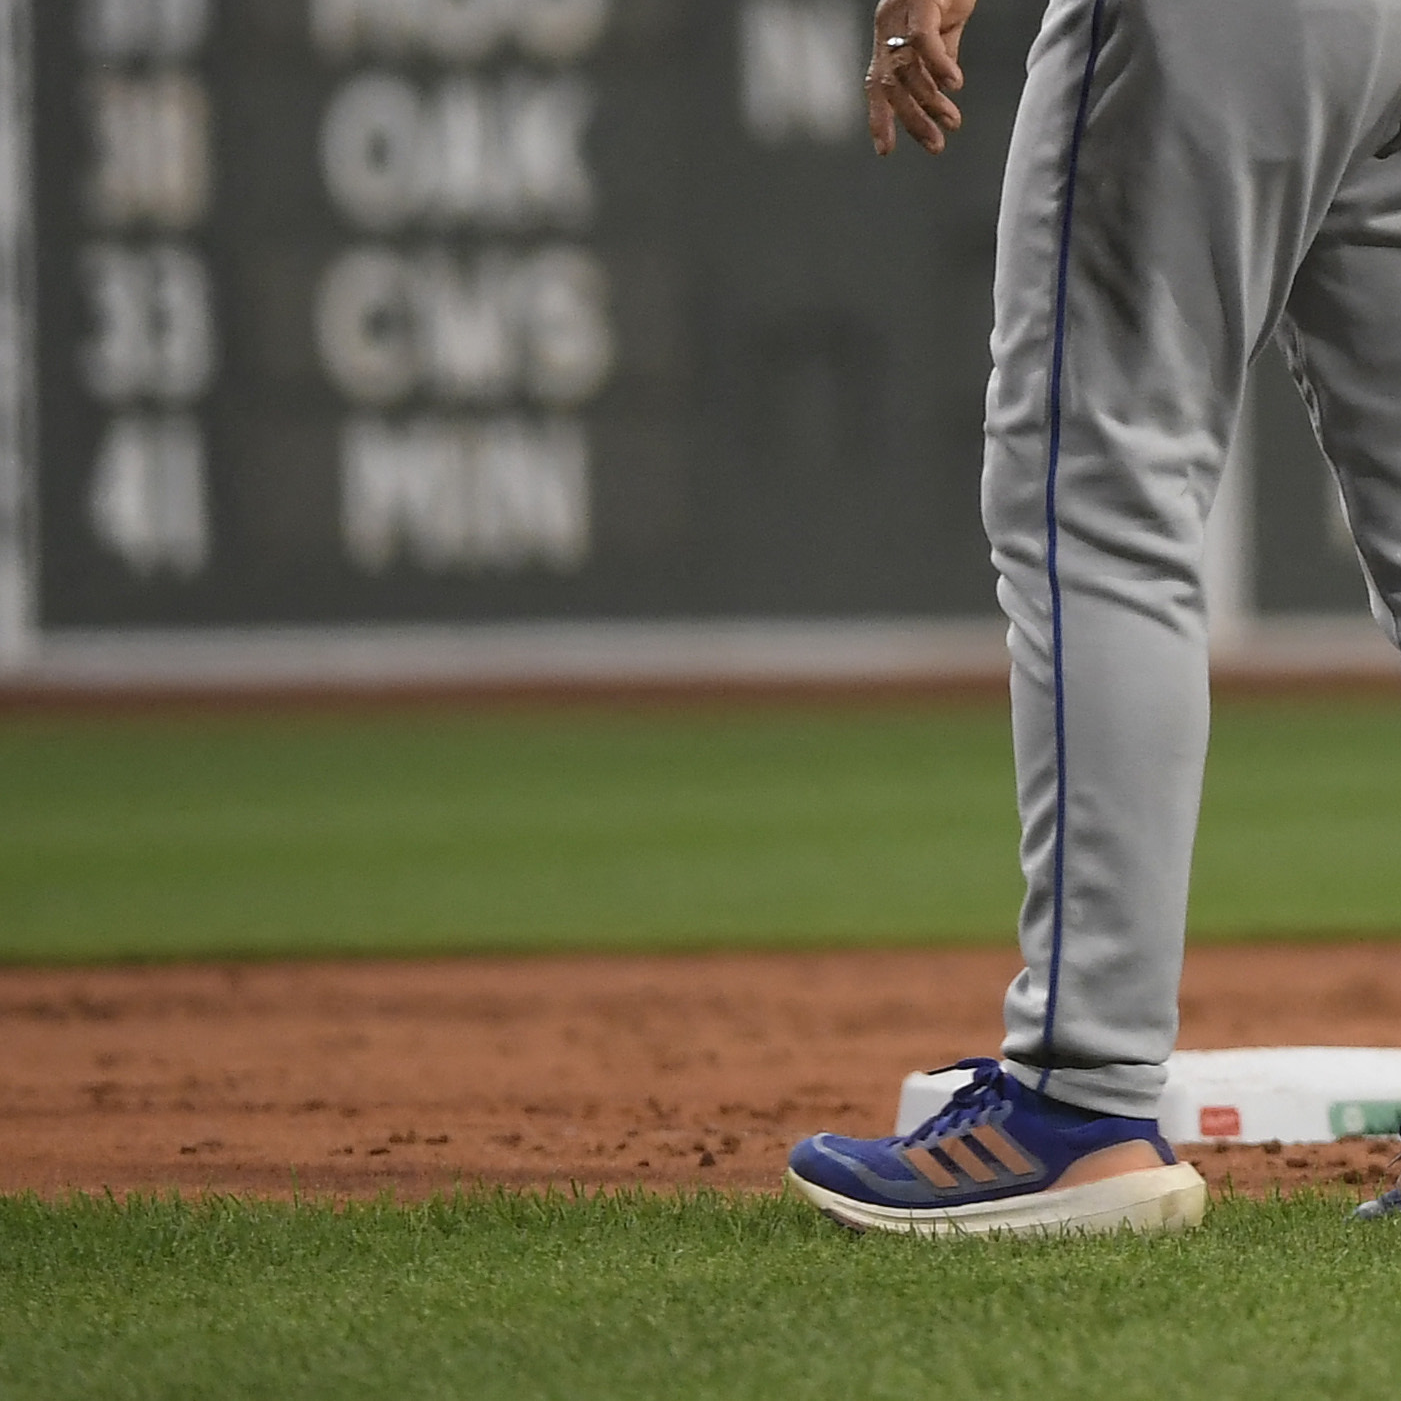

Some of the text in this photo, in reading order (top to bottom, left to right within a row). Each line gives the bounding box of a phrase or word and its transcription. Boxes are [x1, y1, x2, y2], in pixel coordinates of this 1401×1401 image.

[321, 75, 595, 225] OAK
[315, 246, 615, 402] CWS
[340, 417, 592, 564] MIN
